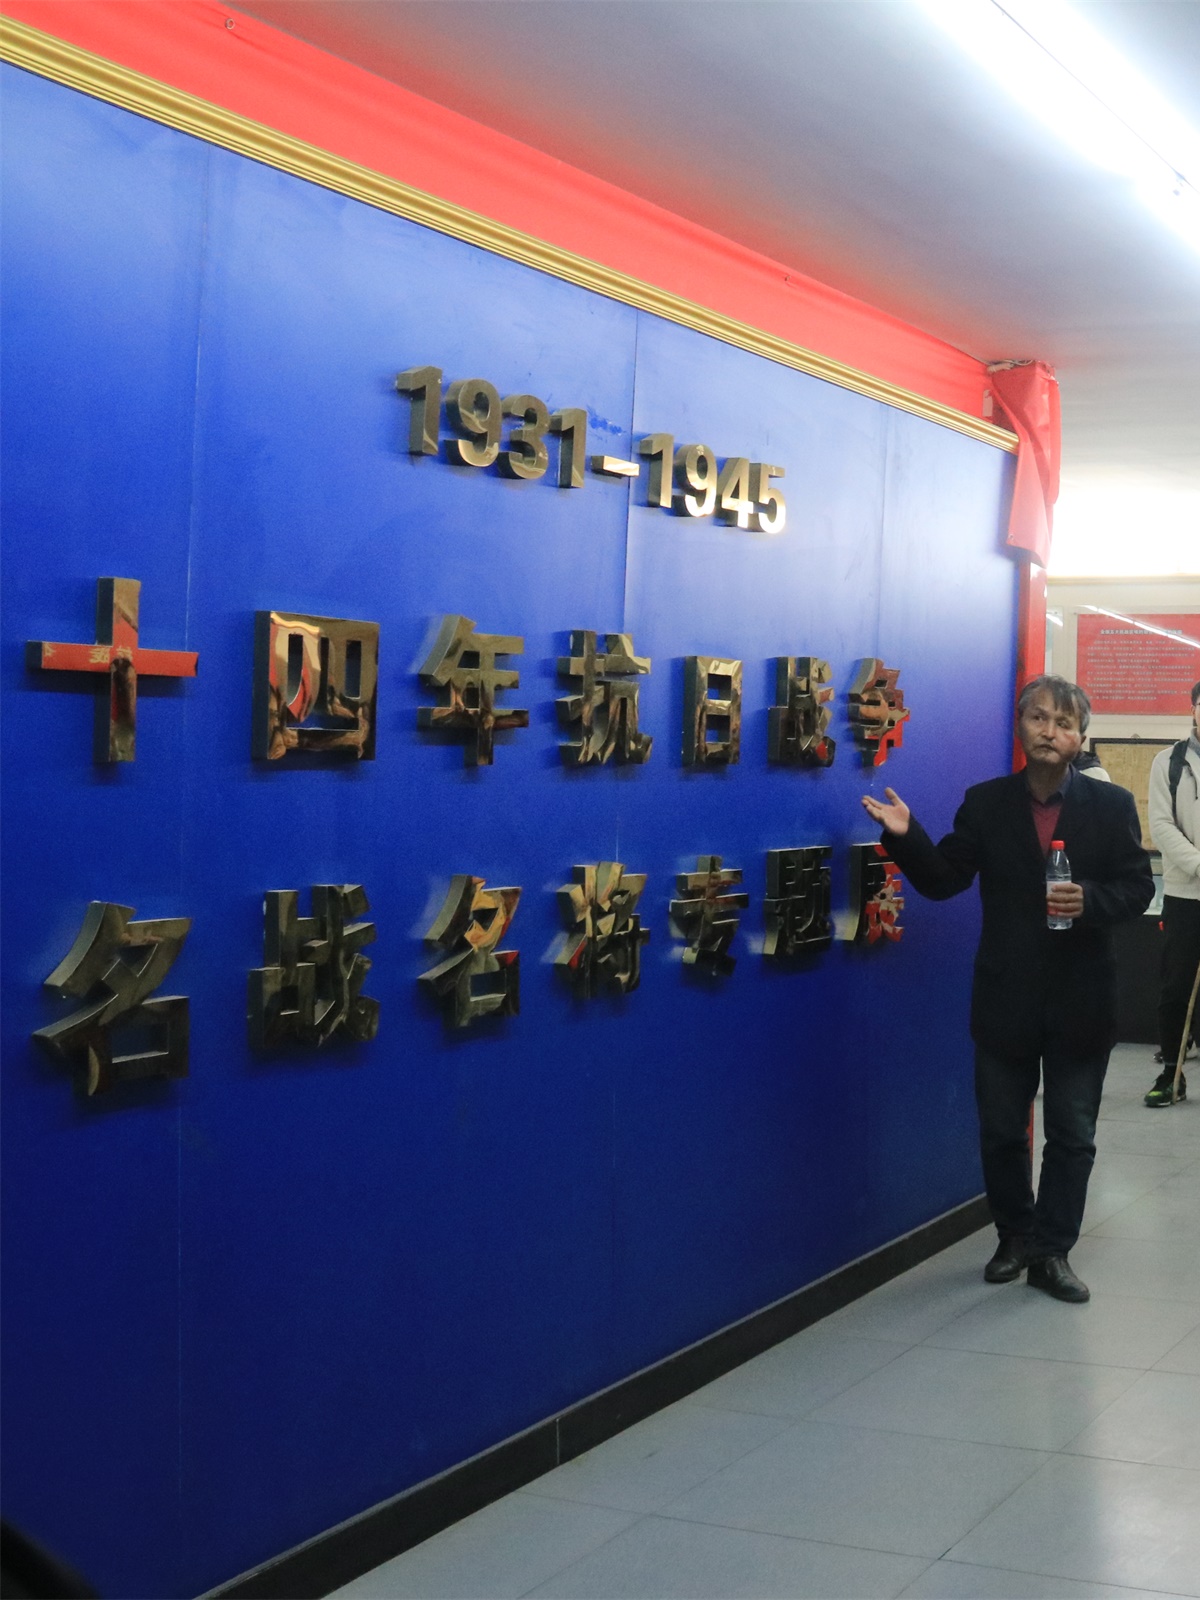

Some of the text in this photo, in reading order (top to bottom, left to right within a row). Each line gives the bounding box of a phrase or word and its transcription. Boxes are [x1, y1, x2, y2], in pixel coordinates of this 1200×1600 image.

[26, 577, 911, 769] 十四年抗日战争
